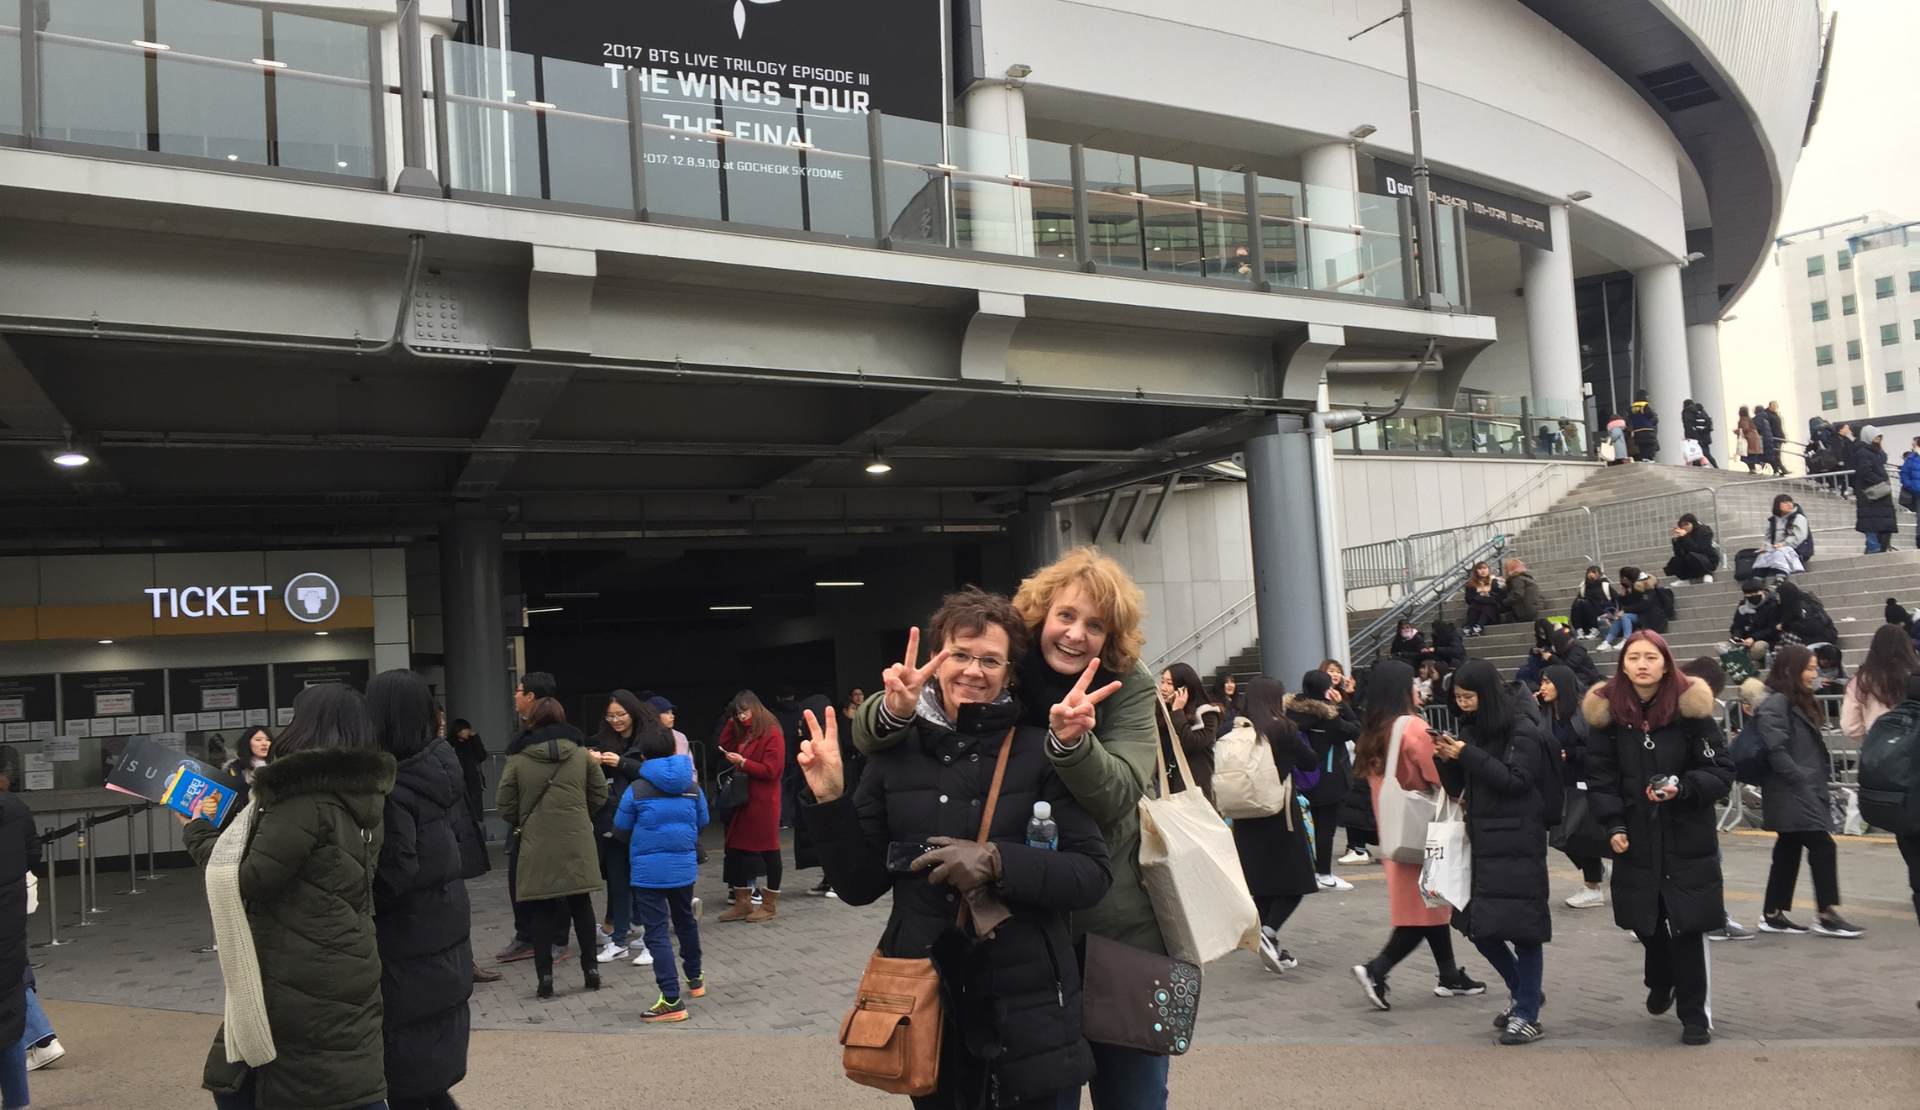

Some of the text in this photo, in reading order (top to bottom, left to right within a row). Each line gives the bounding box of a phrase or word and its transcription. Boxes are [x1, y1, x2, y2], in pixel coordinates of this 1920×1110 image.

[603, 43, 870, 86] 2017 BTS LIVE TRILOGY EPISODE III
[604, 62, 870, 115] THE WINGS TOUR
[723, 161, 735, 170] at
[737, 161, 790, 175] GOCHEOK
[791, 166, 843, 180] SKYDOME
[1397, 182, 1414, 197] GAT
[144, 585, 273, 619] TICKET
